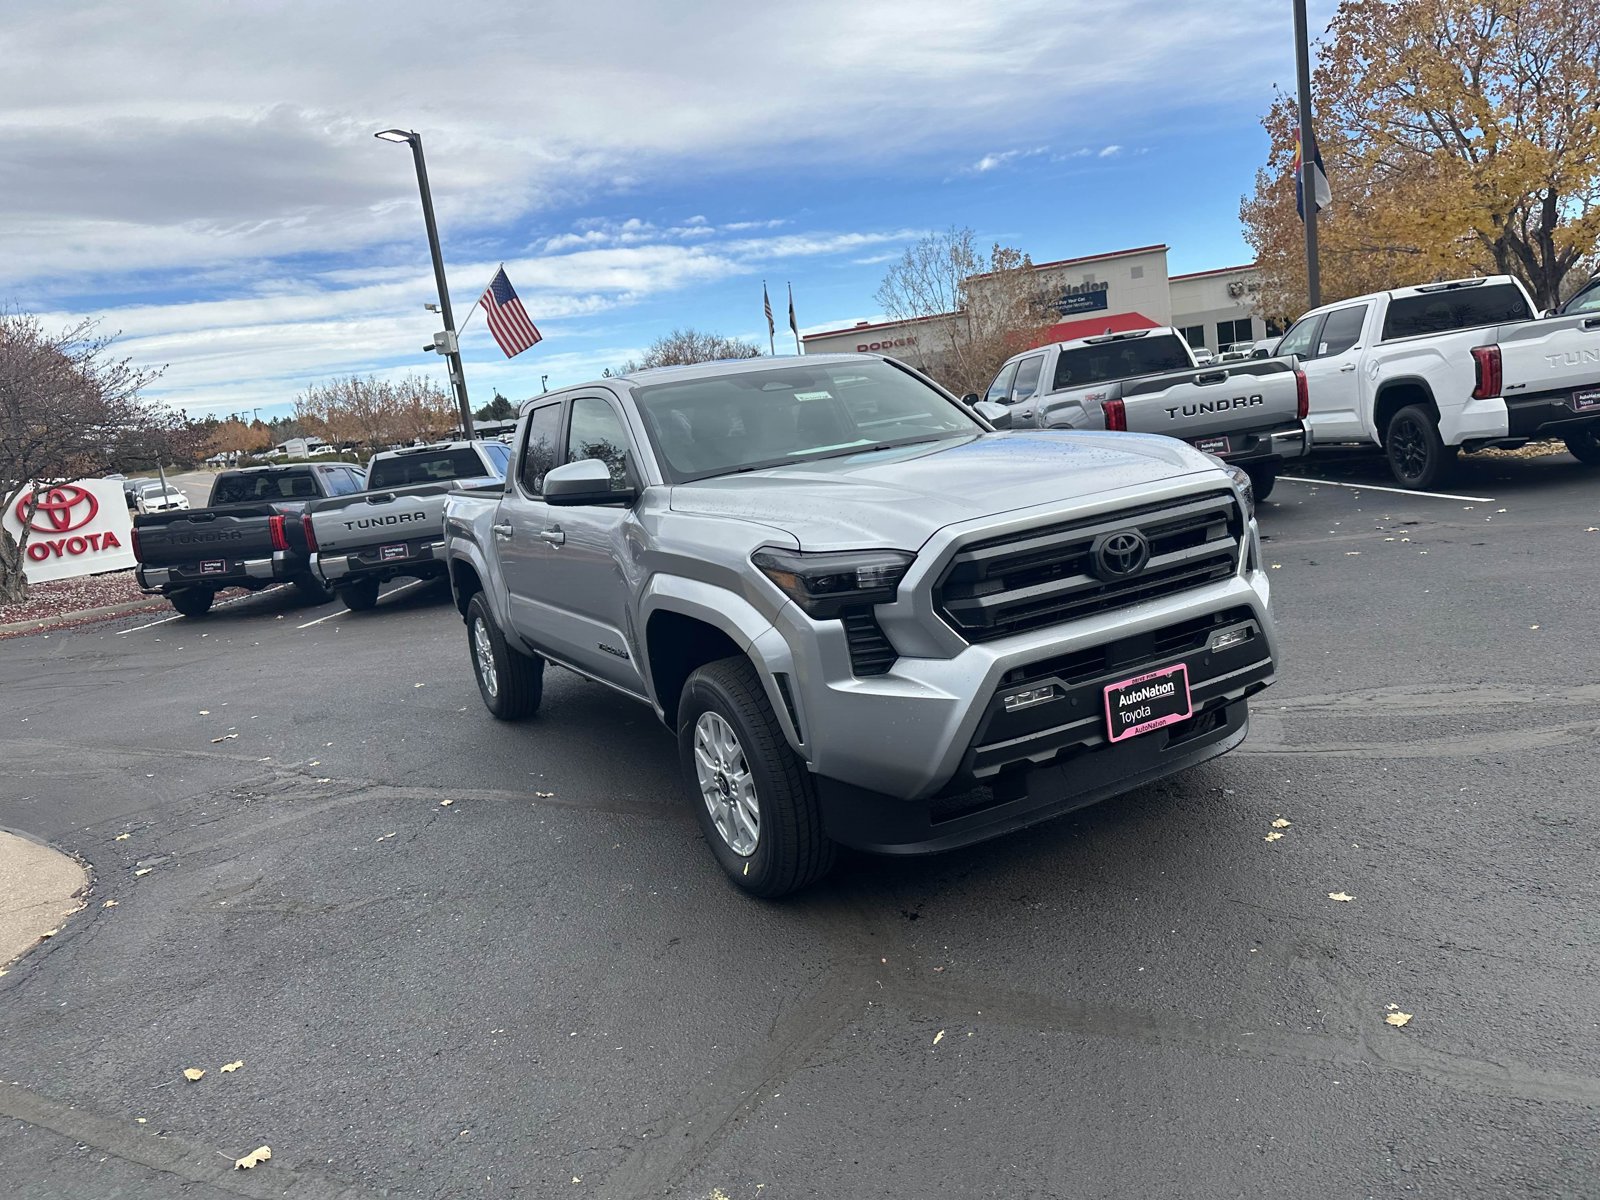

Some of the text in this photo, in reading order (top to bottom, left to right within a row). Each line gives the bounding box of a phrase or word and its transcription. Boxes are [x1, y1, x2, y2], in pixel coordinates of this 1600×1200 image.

[1164, 394, 1264, 420] TUNDRA
[343, 511, 427, 531] TUNDRA
[17, 531, 122, 562] OYOTA
[168, 530, 242, 545] TUNDRA
[1132, 676, 1146, 684] DRIVE
[1119, 682, 1175, 707] AutoNation
[1119, 705, 1151, 724] Toyota
[1134, 719, 1167, 735] AutoNation
